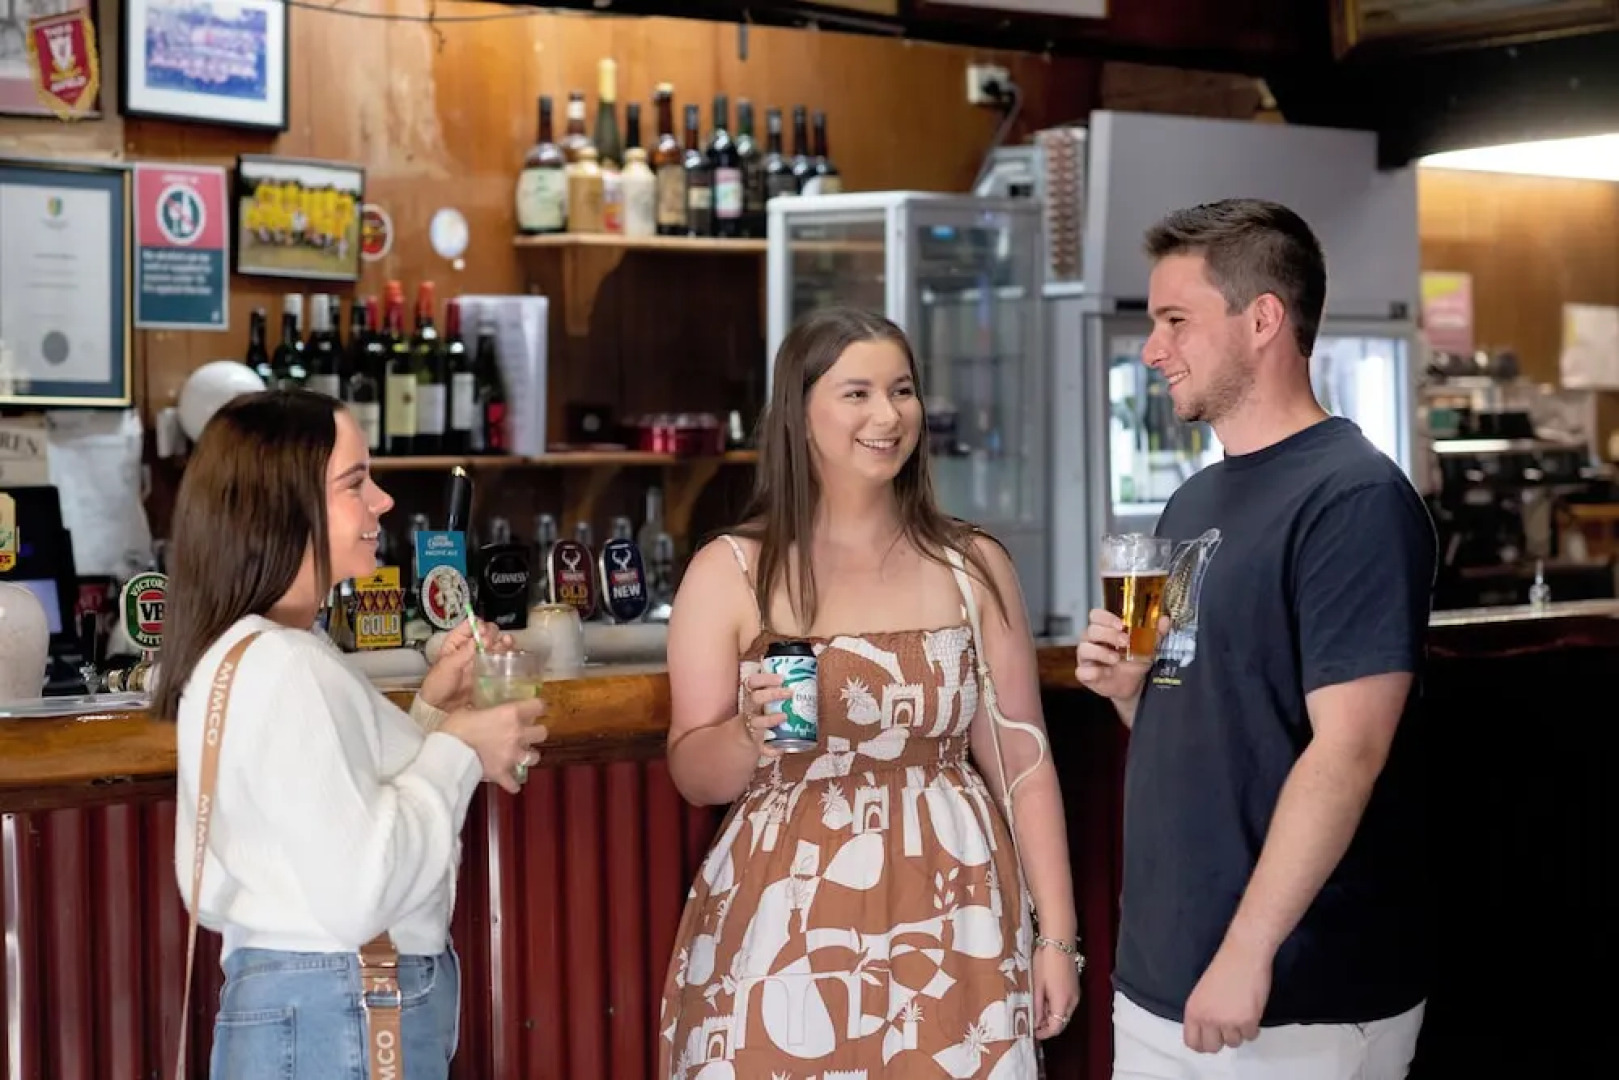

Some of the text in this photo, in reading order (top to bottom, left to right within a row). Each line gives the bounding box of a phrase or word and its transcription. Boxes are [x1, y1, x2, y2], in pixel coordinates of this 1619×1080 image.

[491, 572, 527, 583] GUINNESS
[561, 584, 588, 598] OLD
[612, 583, 640, 599] NEW
[357, 590, 405, 612] XXXX
[362, 615, 399, 636] GOLD
[206, 661, 234, 747] MIMCO
